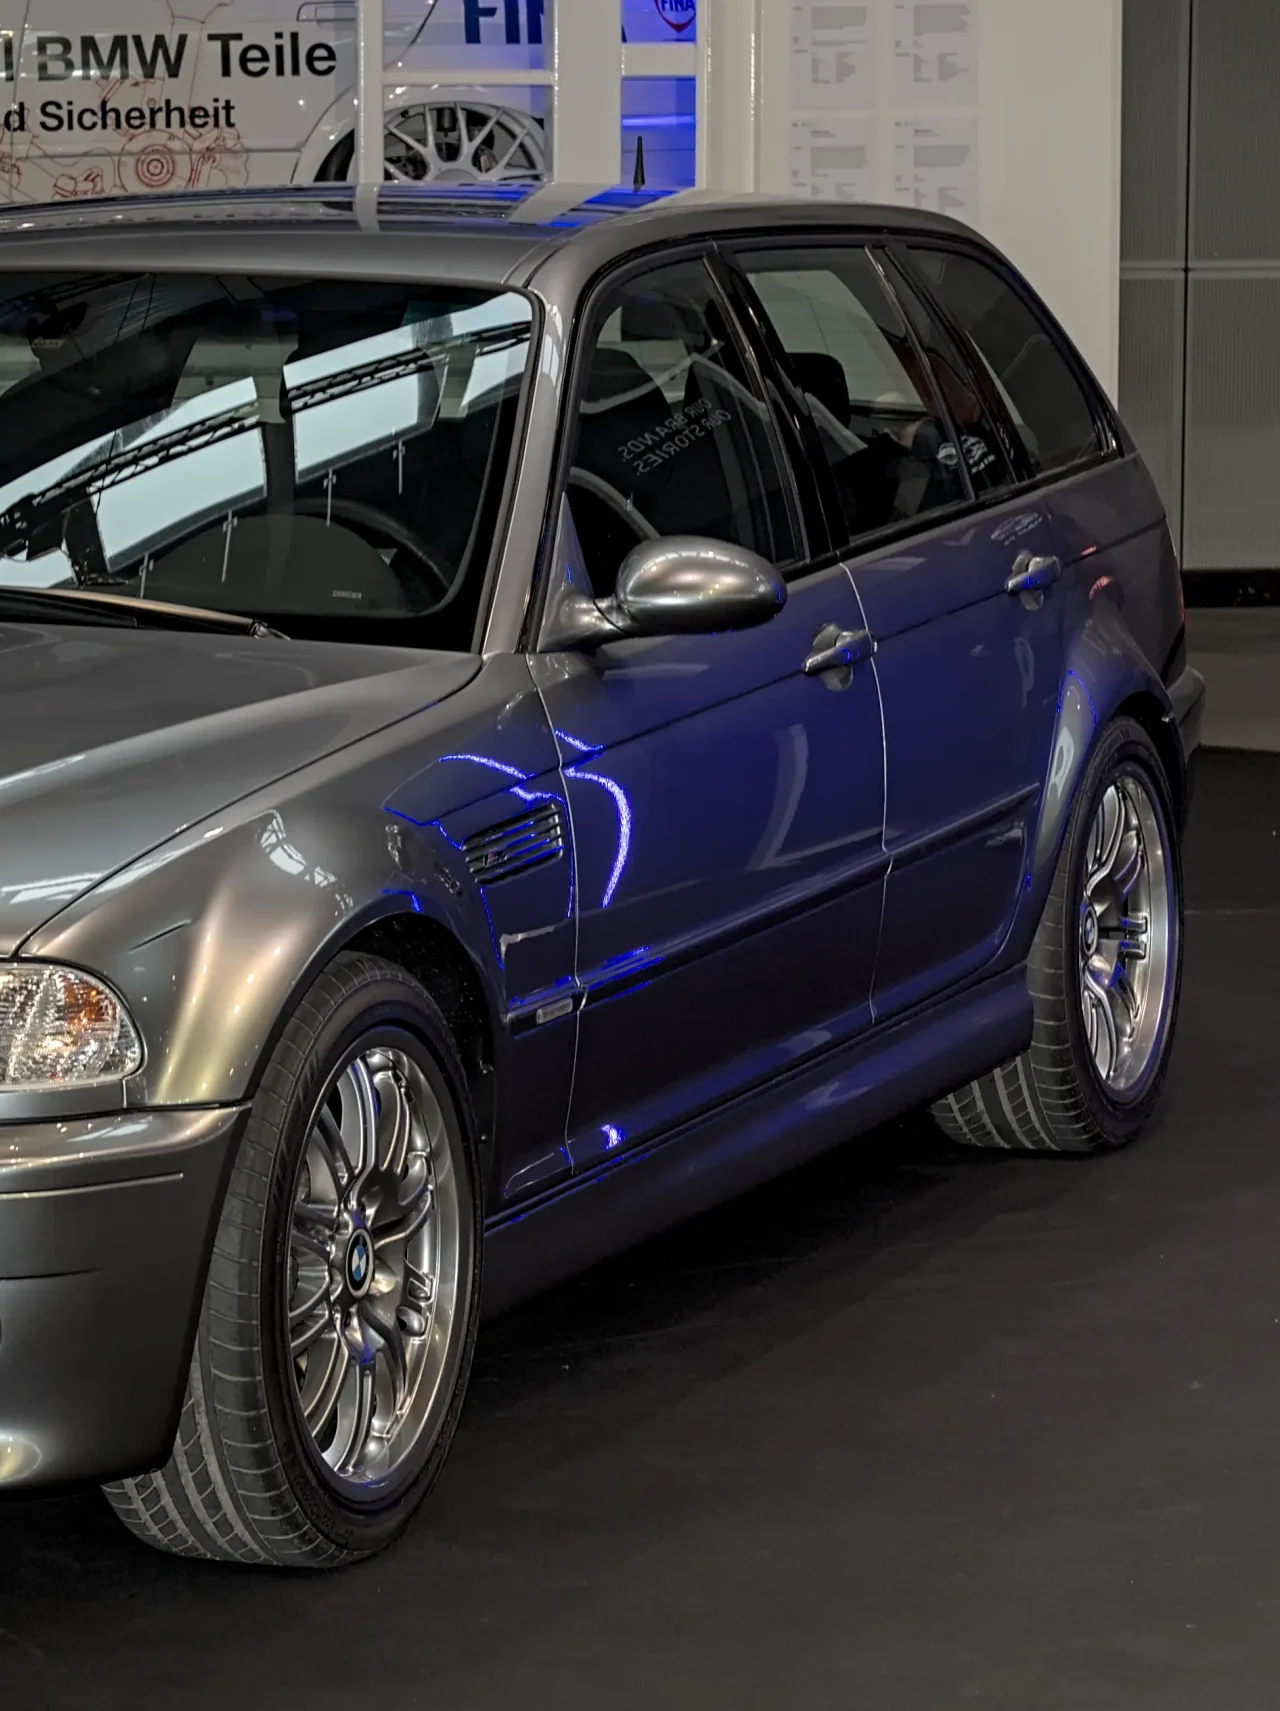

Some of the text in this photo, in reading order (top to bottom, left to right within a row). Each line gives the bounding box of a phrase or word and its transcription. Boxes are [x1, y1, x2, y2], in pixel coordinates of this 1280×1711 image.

[36, 33, 188, 81] BMW
[207, 31, 337, 78] Teile
[39, 97, 236, 132] Sicherheit
